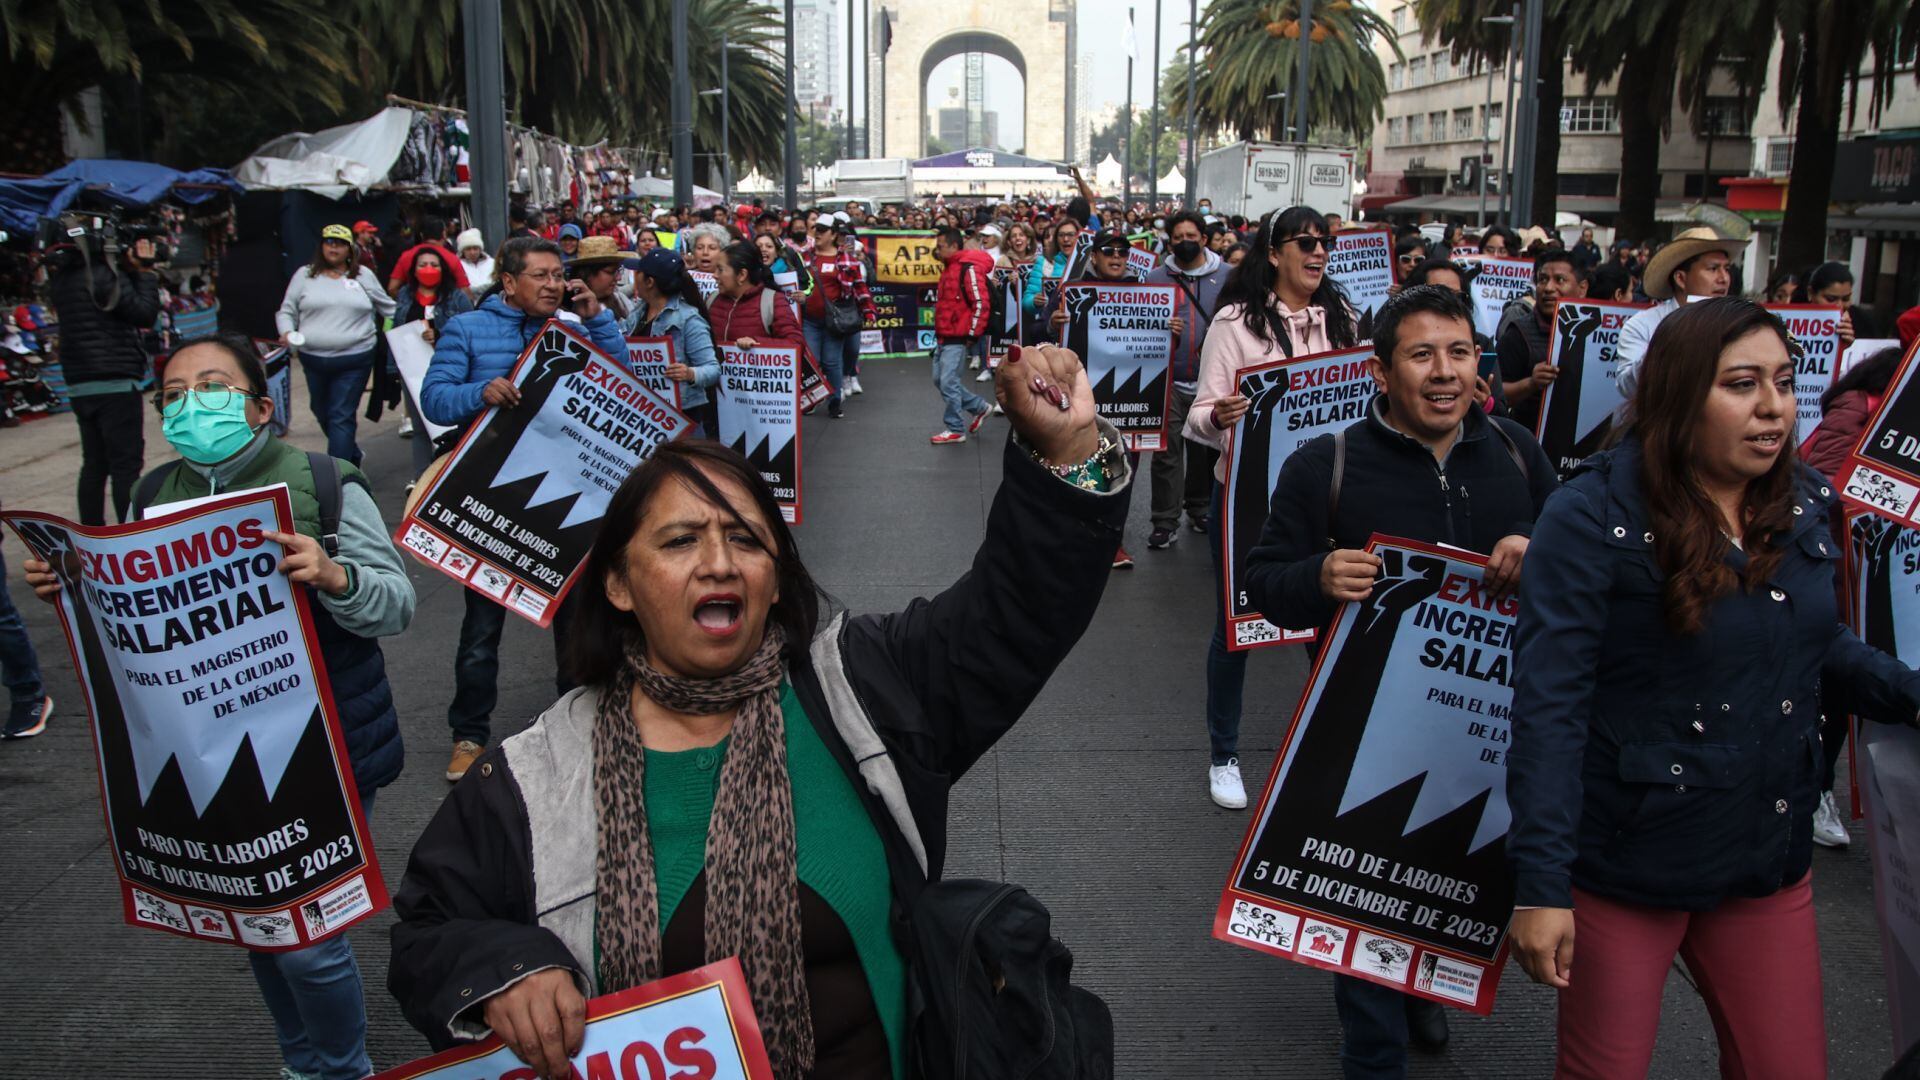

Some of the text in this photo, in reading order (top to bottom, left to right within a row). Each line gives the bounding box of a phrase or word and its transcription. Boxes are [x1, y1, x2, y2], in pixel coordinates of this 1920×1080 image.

[883, 264, 891, 275] A
[895, 264, 909, 275] LA
[1129, 252, 1150, 268] MOS
[1327, 259, 1388, 275] SALARIAL
[1483, 263, 1531, 279] EXIGIM
[1476, 276, 1527, 290] INCREME
[1099, 291, 1169, 305] EXIGIMOS
[1093, 306, 1170, 318] INCREMENTO
[1099, 318, 1169, 330] SALARIAL
[725, 351, 791, 367] EXIGIMOS
[1800, 340, 1833, 354] NTO
[632, 364, 667, 376] ENTO
[721, 365, 793, 379] INCREMENTO
[1290, 360, 1373, 392] EXIGIM
[582, 360, 678, 431] EXIGIMOS
[727, 379, 792, 394] SALARIAL
[1280, 381, 1379, 413] INCREMENT
[564, 374, 667, 444] INCREMENTO
[1102, 403, 1112, 413] DE
[1114, 402, 1149, 412] LABORES
[1287, 400, 1368, 432] SALARI
[563, 396, 653, 460] SALARIAL
[1128, 417, 1138, 426] DE
[1140, 416, 1161, 426] 2023
[560, 425, 583, 443] PARA
[582, 439, 592, 450] EL
[1880, 428, 1899, 450] 5
[578, 451, 590, 463] DE
[590, 458, 601, 470] LA
[580, 468, 592, 480] DE
[773, 487, 795, 498] 2023
[1847, 485, 1905, 514] CNTE
[460, 495, 560, 560] PARO DE LABORES
[80, 518, 267, 586] EXIGIMOS
[405, 536, 439, 561] CNTE
[428, 501, 442, 516] 5
[438, 509, 459, 528] DE
[456, 519, 518, 562] DICIEMBRE
[515, 554, 534, 573] DE
[531, 563, 564, 589] 2023
[86, 552, 277, 618] INCREMENTO
[1239, 591, 1248, 606] 5
[104, 585, 285, 654] SALARIAL
[1237, 632, 1278, 644] CNTE
[126, 630, 289, 687] PARA EL MAGISTERIO
[1420, 638, 1515, 688] SALA
[182, 652, 295, 706] DE LA CIUDAD
[213, 673, 301, 719] DE MÉXICO
[1427, 687, 1465, 709] PARA
[1467, 697, 1484, 714] EL
[1468, 721, 1508, 743] DE LA
[1480, 748, 1501, 765] DE
[137, 818, 309, 864] PARO DE LABORES
[125, 835, 354, 897] 5 DE DICIEMBRE DE 2023
[1301, 837, 1479, 904] PARO DE LABORES
[1253, 861, 1500, 946] 5 DE DICIEMBRE DE 2023
[138, 908, 189, 931] CNTE
[1230, 923, 1291, 948] CNTE
